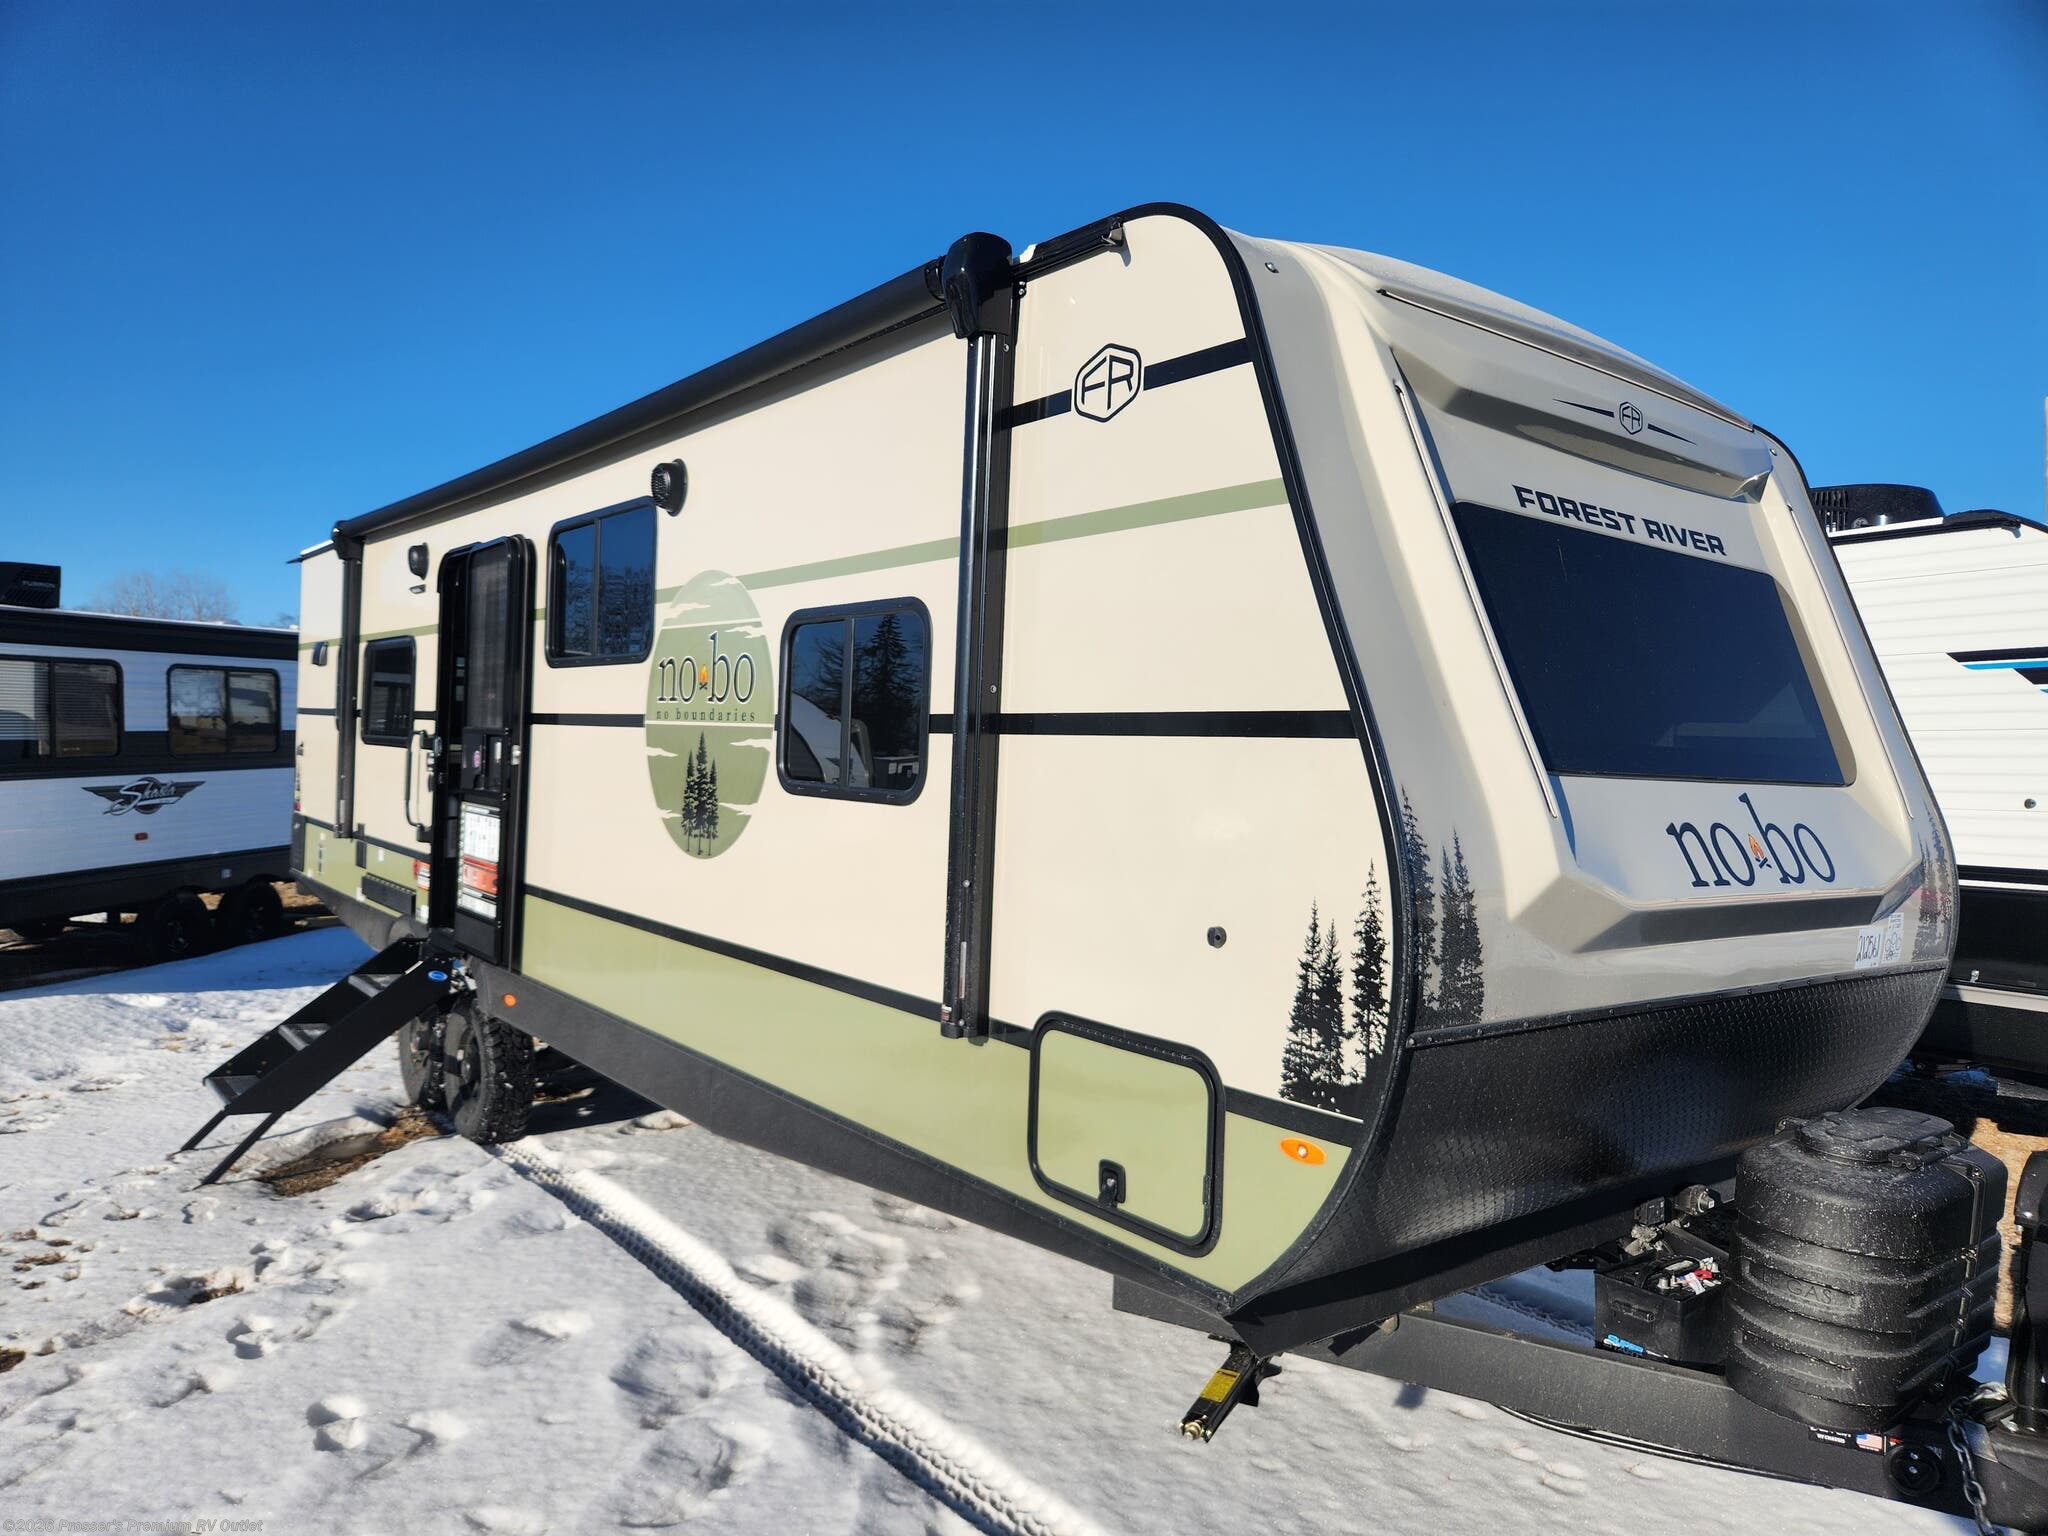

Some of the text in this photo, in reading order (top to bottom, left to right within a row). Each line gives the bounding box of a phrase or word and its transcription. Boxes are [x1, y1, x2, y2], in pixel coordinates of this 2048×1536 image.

[1511, 484, 1727, 556] FOREST RIVER
[656, 707, 756, 721] no boundaries
[1786, 1279, 1833, 1305] GAS
